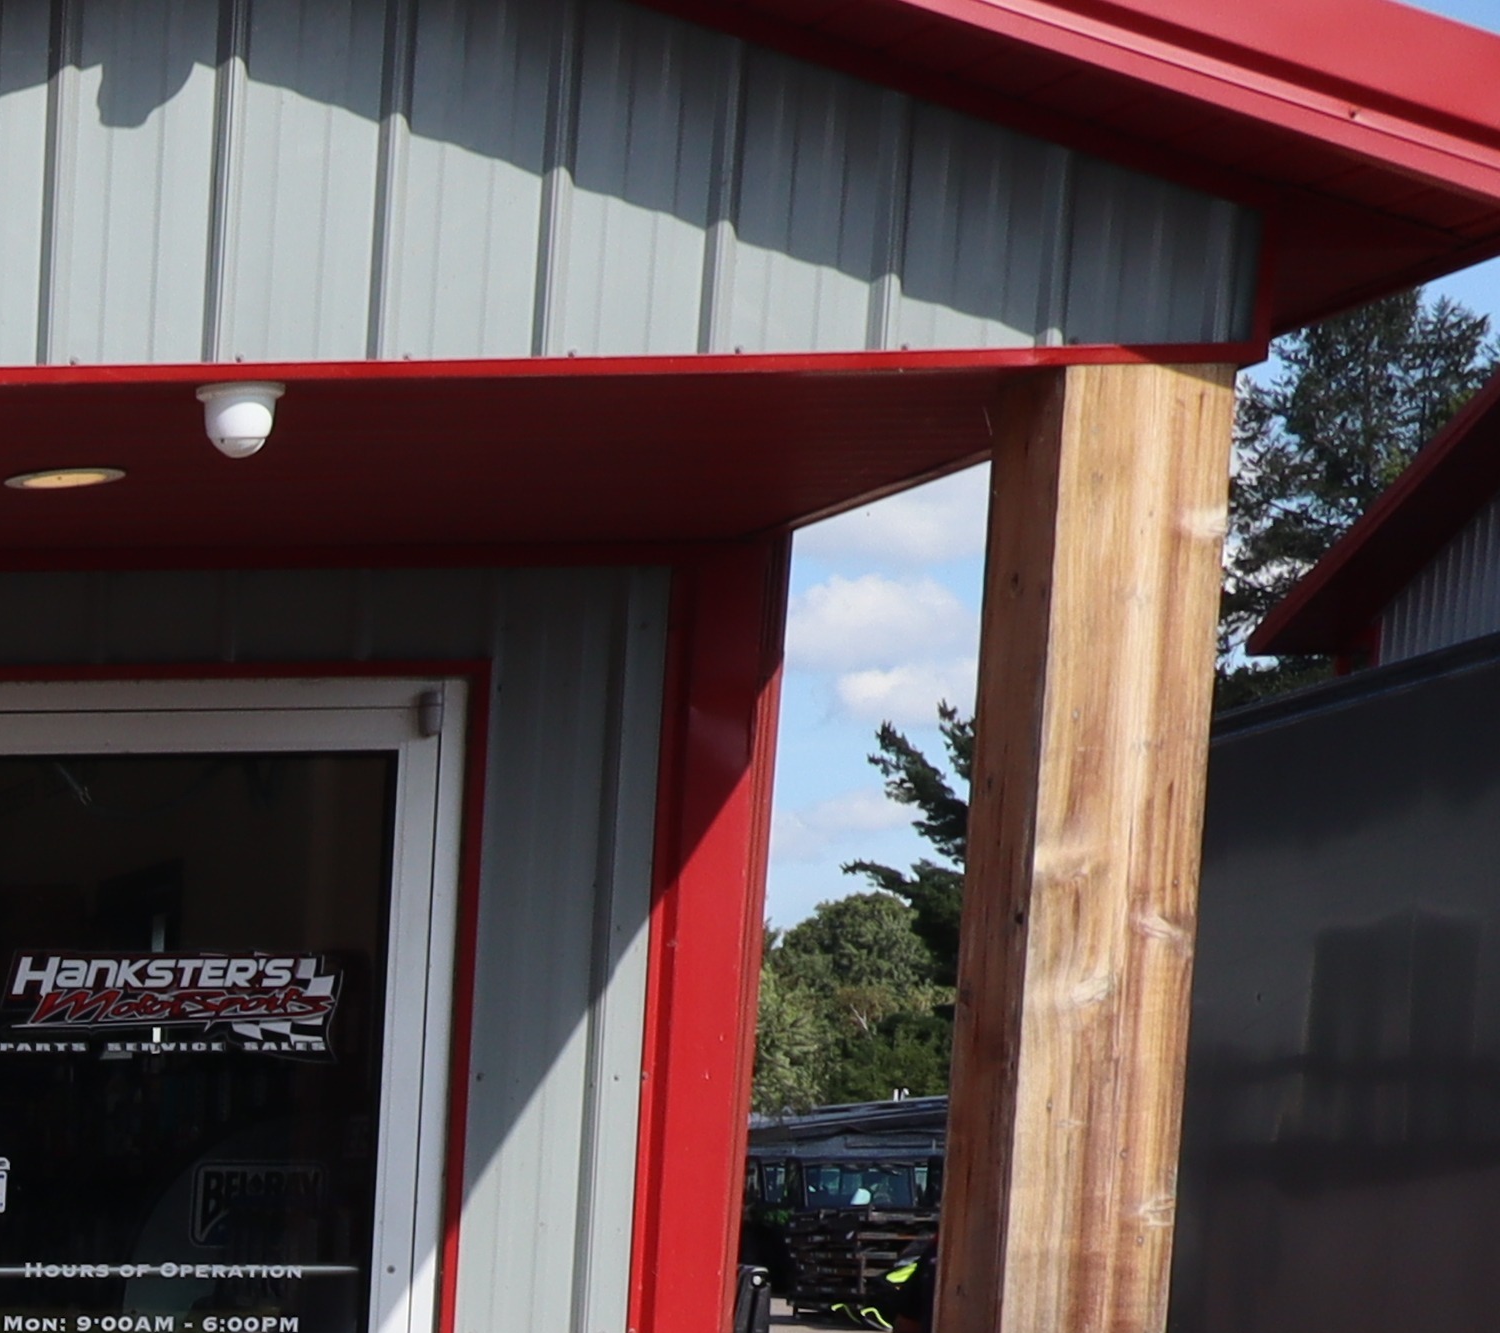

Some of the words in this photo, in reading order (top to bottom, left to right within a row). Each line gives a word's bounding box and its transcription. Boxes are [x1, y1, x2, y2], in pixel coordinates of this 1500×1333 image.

[11, 956, 295, 995] HANKSTER'S
[0, 1041, 88, 1052] PARTS
[107, 1041, 226, 1052] SERVICE
[244, 1041, 327, 1052] SALES
[24, 1262, 110, 1278] HOURS
[119, 1264, 151, 1278] OF
[159, 1262, 303, 1279] OPERATION
[4, 1315, 66, 1332] MON:
[202, 1316, 299, 1333] 6:00PM
